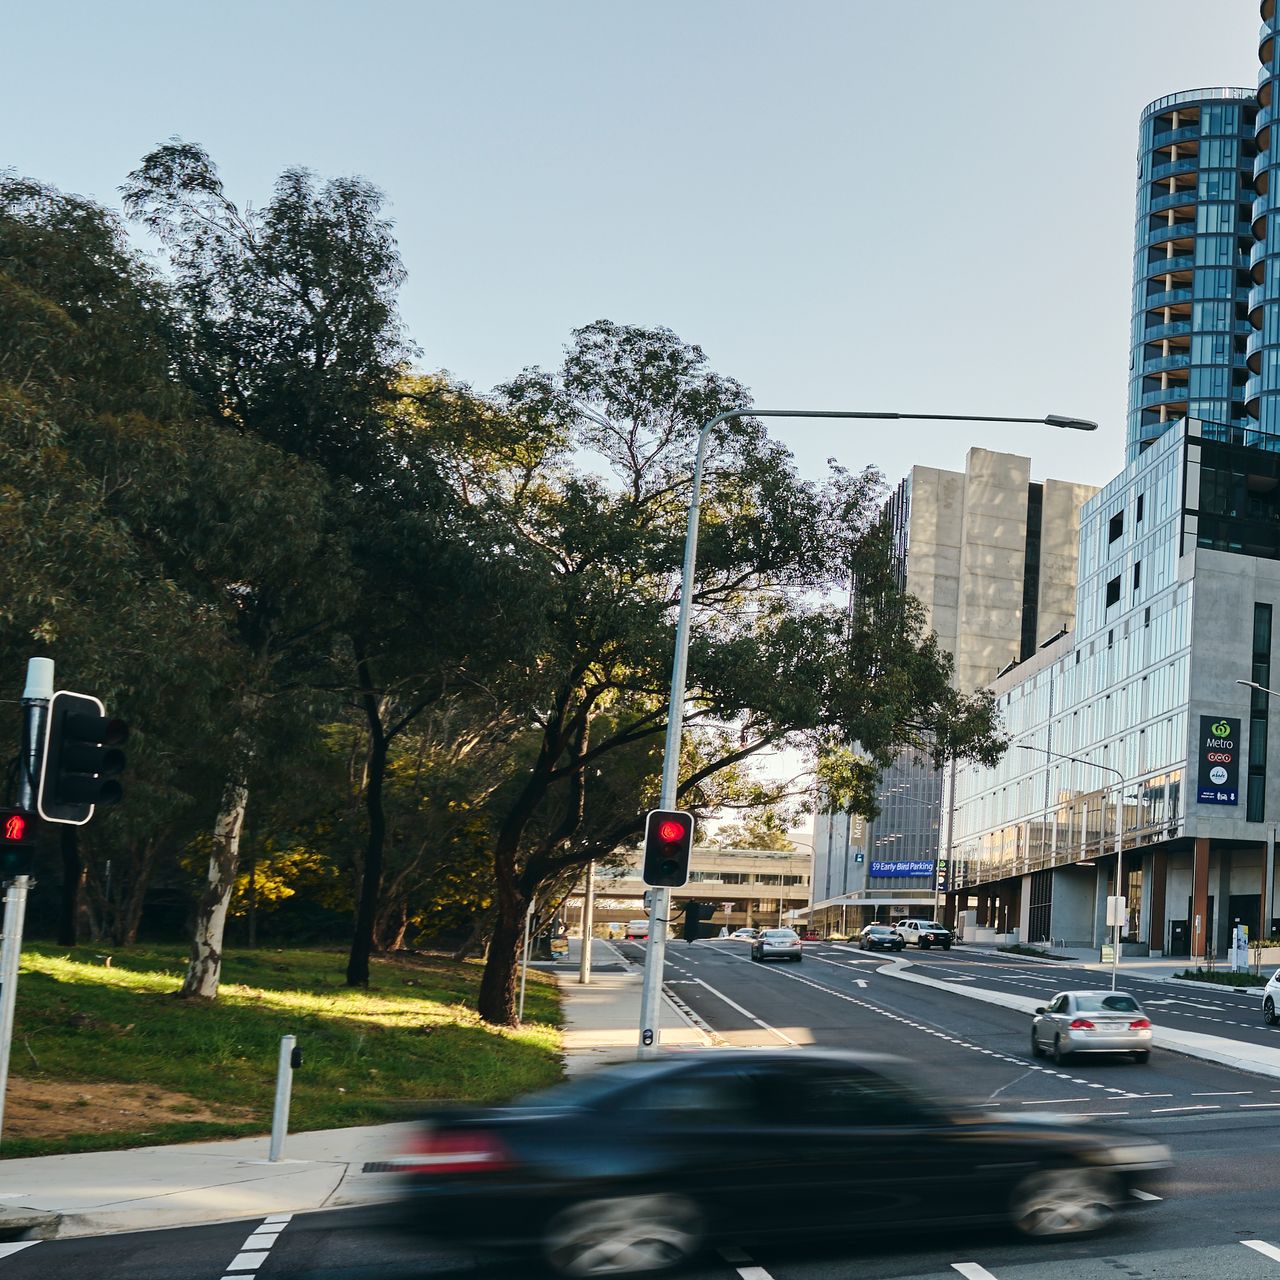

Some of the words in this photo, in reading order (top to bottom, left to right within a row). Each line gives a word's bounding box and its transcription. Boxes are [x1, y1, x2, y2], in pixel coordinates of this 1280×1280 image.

[1206, 738, 1234, 750] Metro
[880, 862, 896, 872] Early
[896, 862, 909, 871] Bird
[909, 862, 934, 872] Parking
